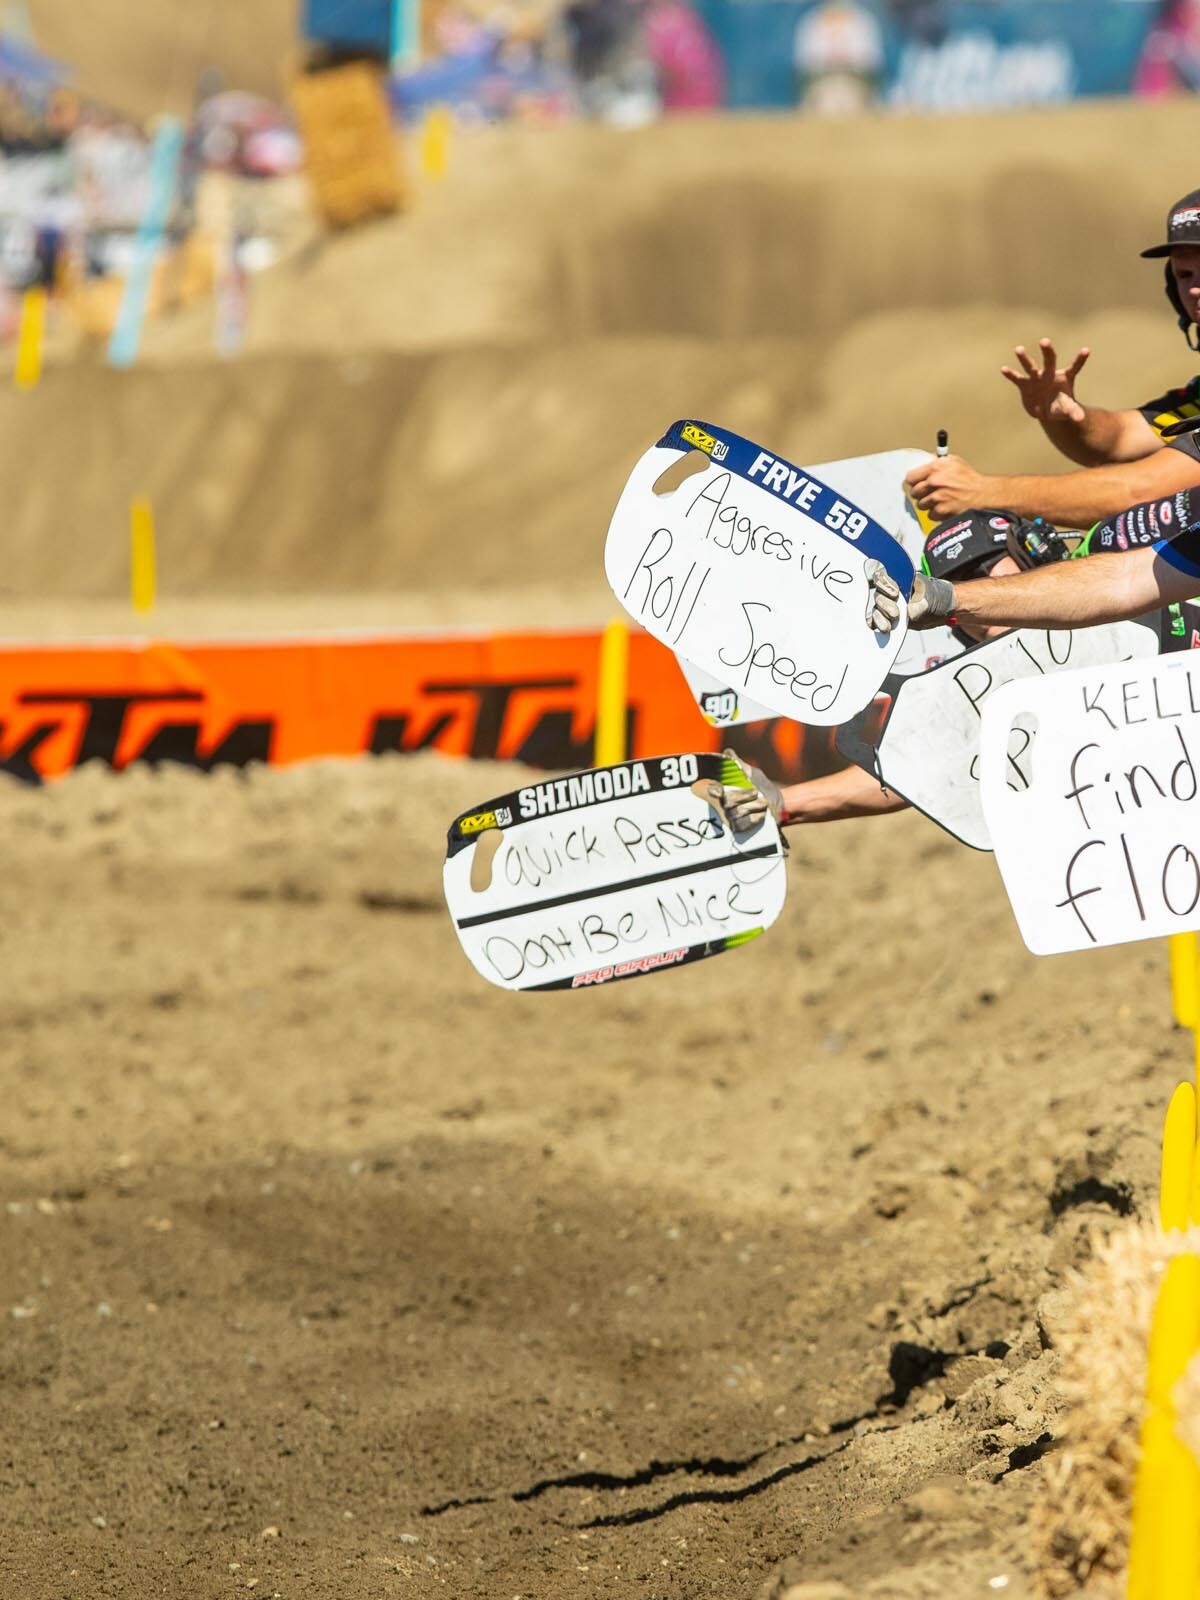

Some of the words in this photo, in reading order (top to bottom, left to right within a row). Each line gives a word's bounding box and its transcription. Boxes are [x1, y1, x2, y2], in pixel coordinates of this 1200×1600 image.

[685, 472, 854, 603] Aggresive
[747, 451, 823, 511] FRYE
[824, 503, 869, 541] 59
[623, 528, 711, 645] Roll
[718, 602, 849, 712] Speed
[704, 693, 736, 716] 90
[518, 761, 651, 818] SHIMODA
[661, 754, 699, 789] 30
[1064, 724, 1197, 830] find
[505, 825, 606, 887] Quick
[481, 926, 575, 981] Dont
[578, 912, 648, 954] Be
[656, 883, 763, 938] Nice
[571, 965, 614, 988] PRO
[614, 947, 690, 976] CIRCUIT
